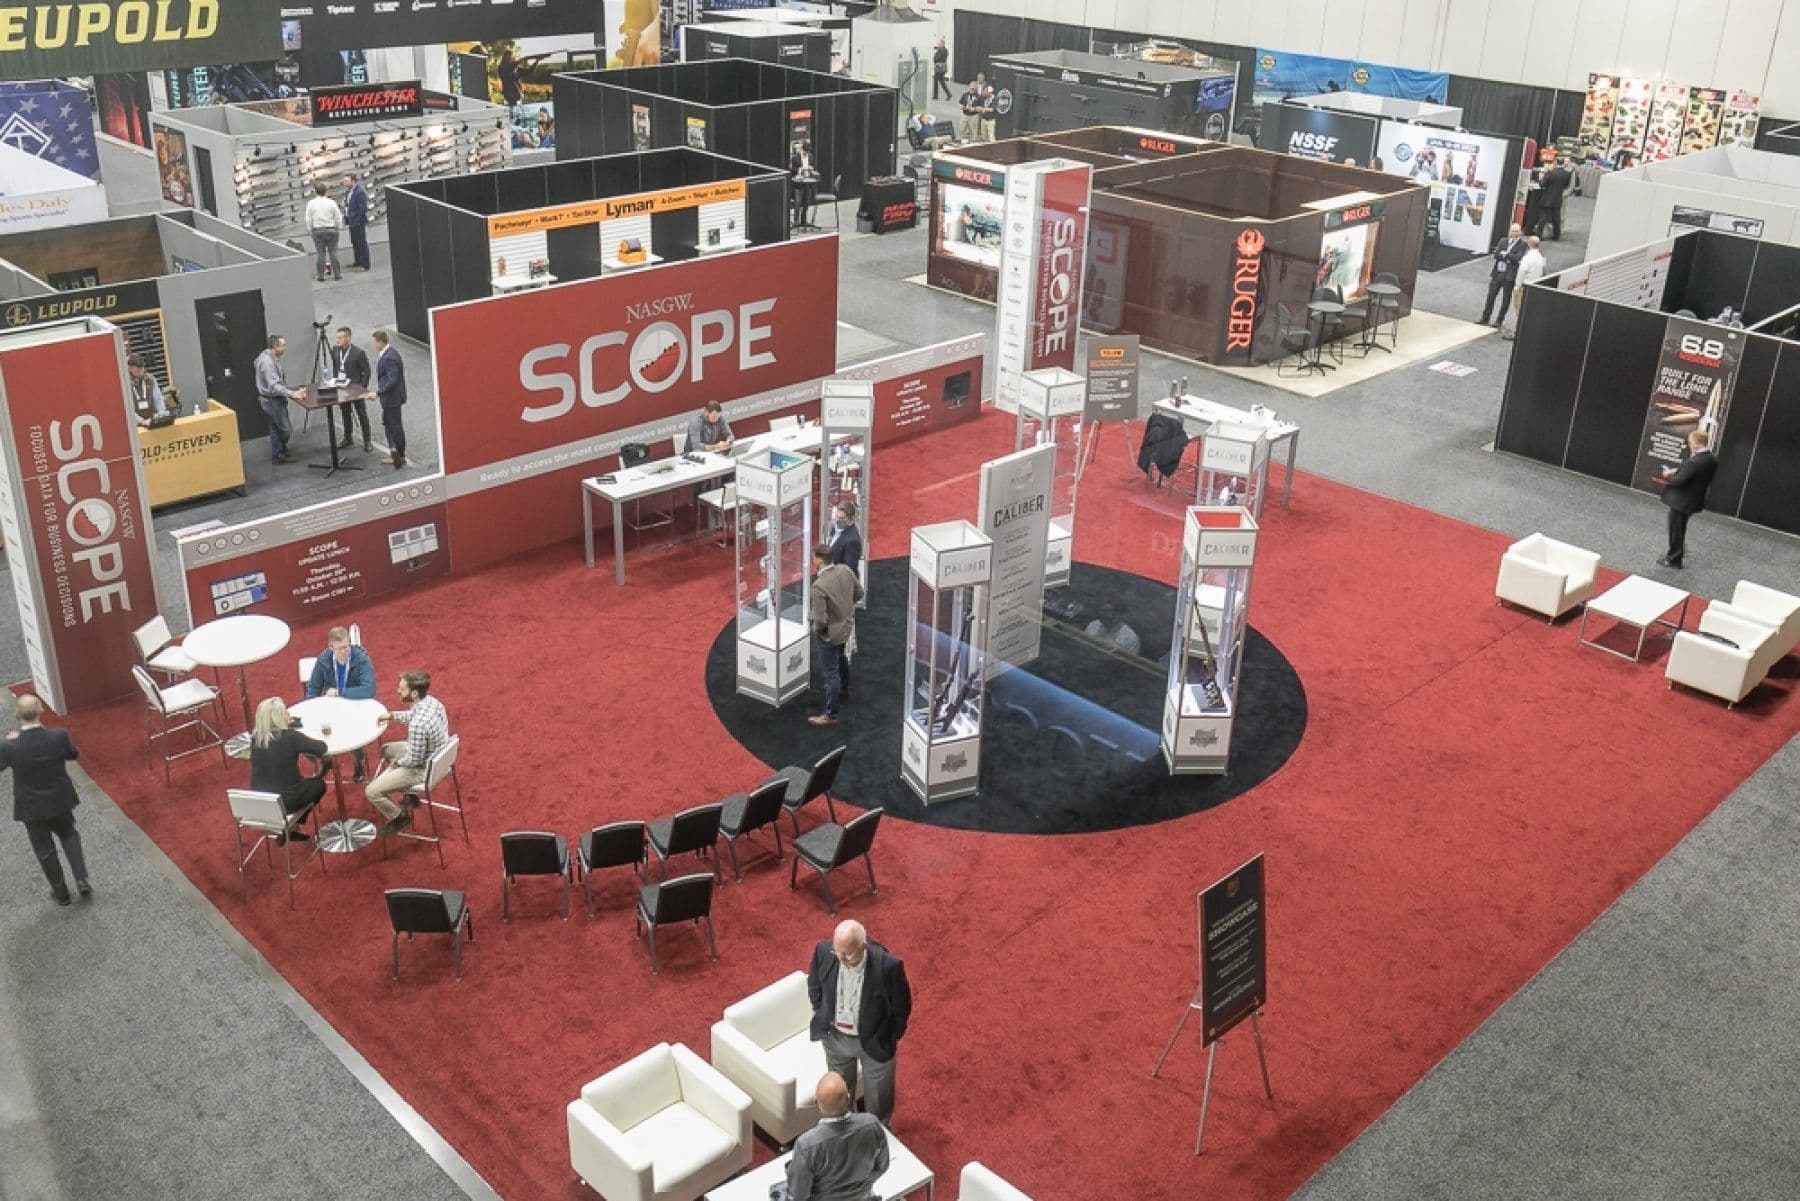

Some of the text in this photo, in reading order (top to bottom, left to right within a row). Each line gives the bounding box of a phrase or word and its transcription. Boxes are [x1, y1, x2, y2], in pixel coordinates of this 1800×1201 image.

[317, 89, 416, 111] WINCHESTER
[1149, 140, 1176, 154] RUGER
[1290, 131, 1339, 151] NSSF
[963, 170, 992, 185] RUGER
[606, 200, 655, 218] Lyman
[1045, 217, 1076, 356] SCOPE
[38, 294, 118, 320] LEUPOLD
[625, 293, 693, 325] NASGW
[1227, 257, 1261, 353] RUGER
[521, 297, 778, 424] SCOPE
[1660, 375, 1709, 395] THE LONG
[1661, 366, 1712, 387] BUILT FOR
[30, 424, 48, 473] FOCUSED
[1208, 447, 1246, 464] CALIBER
[480, 467, 509, 482] Ready
[523, 458, 552, 472] access
[554, 452, 568, 462] the
[570, 447, 592, 459] most
[50, 413, 133, 624] SCOPE
[993, 495, 1045, 529] CALIBER
[48, 524, 67, 573] BUSINESS
[309, 540, 339, 556] SCOPE
[1204, 544, 1249, 556] CALIBER
[944, 559, 986, 577] CALIBER
[56, 576, 77, 628] DECISIONS
